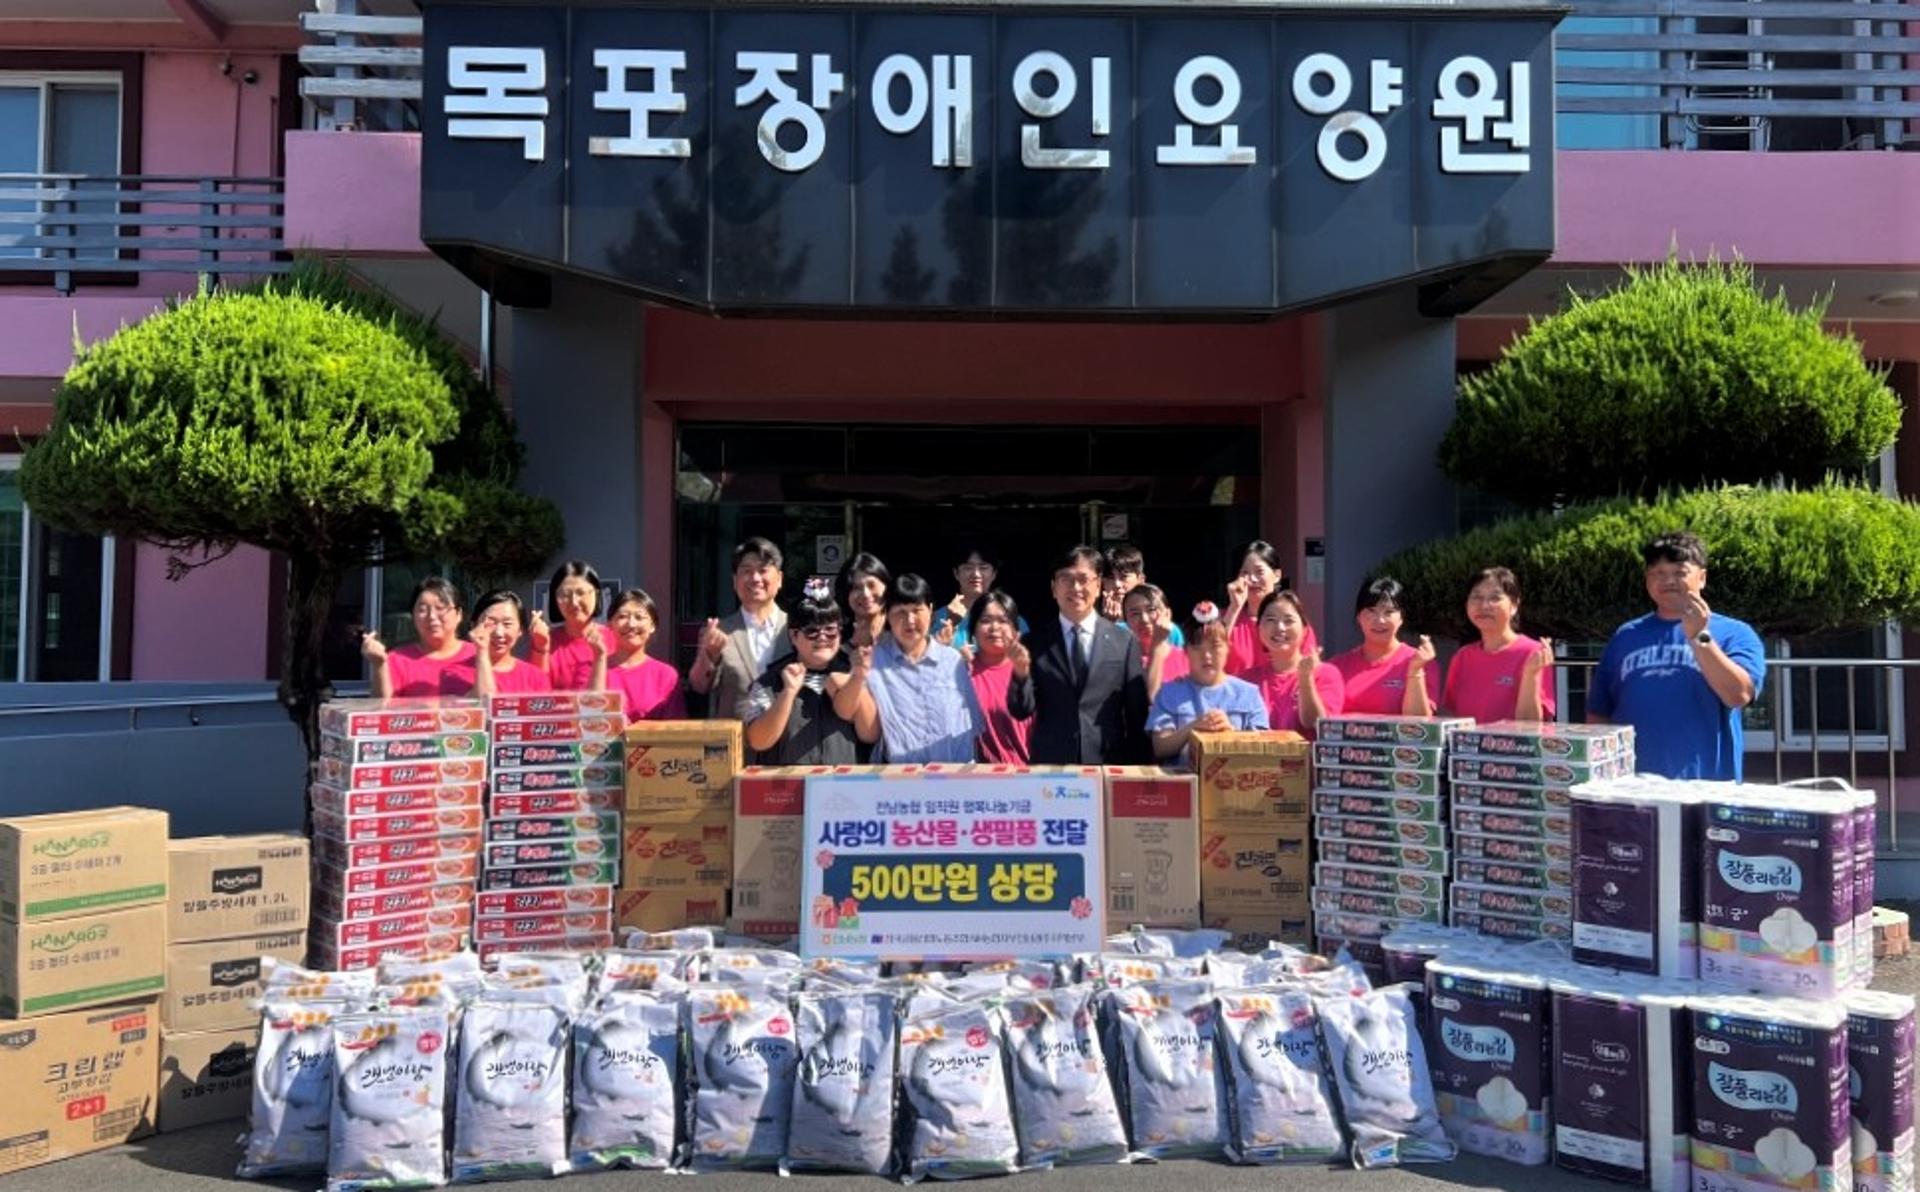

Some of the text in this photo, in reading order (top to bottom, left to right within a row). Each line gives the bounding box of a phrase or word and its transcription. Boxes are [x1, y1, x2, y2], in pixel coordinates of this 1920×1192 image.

[443, 46, 1532, 181] 목포장애인요양원
[819, 820, 886, 847] 사랑의
[1043, 819, 1088, 846] 전달
[852, 863, 1057, 903] 500만원 상당
[71, 1099, 103, 1117] 2+1
